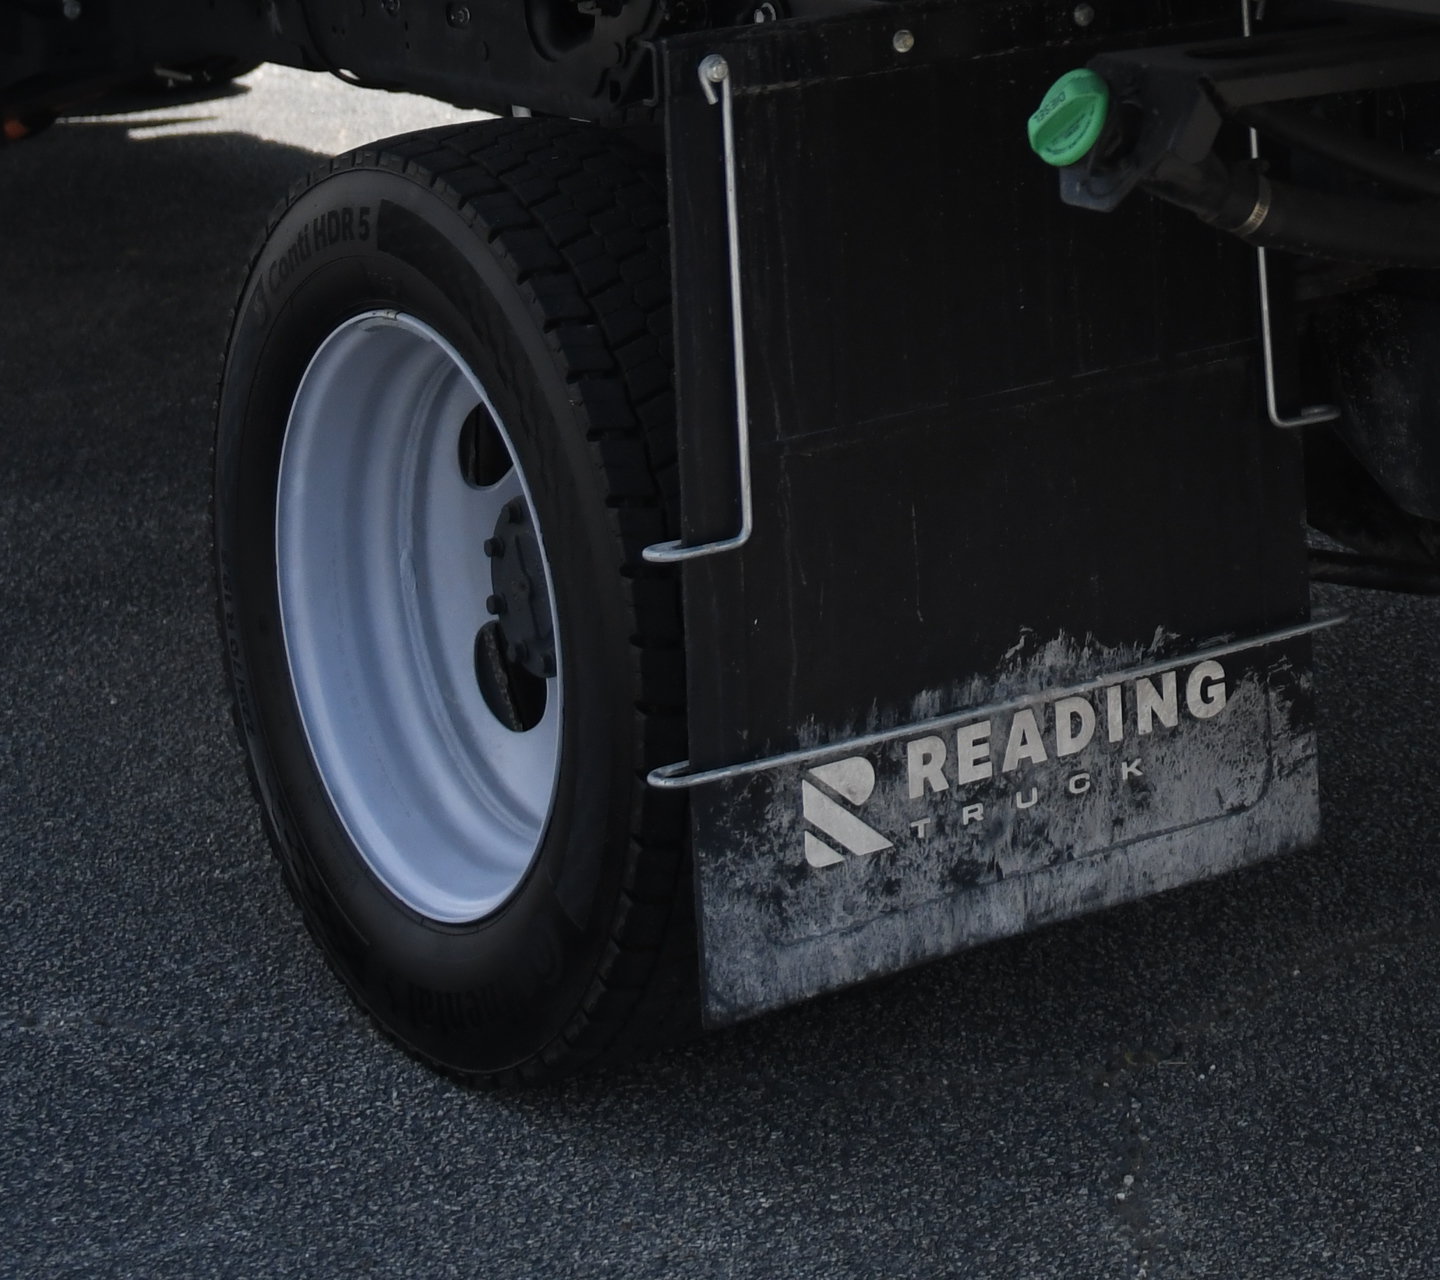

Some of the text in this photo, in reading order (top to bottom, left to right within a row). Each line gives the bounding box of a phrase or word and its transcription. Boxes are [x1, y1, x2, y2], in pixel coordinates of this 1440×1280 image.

[269, 207, 370, 294] Conti HDR 5
[907, 659, 1228, 801] READING
[910, 757, 1144, 840] TRUCK
